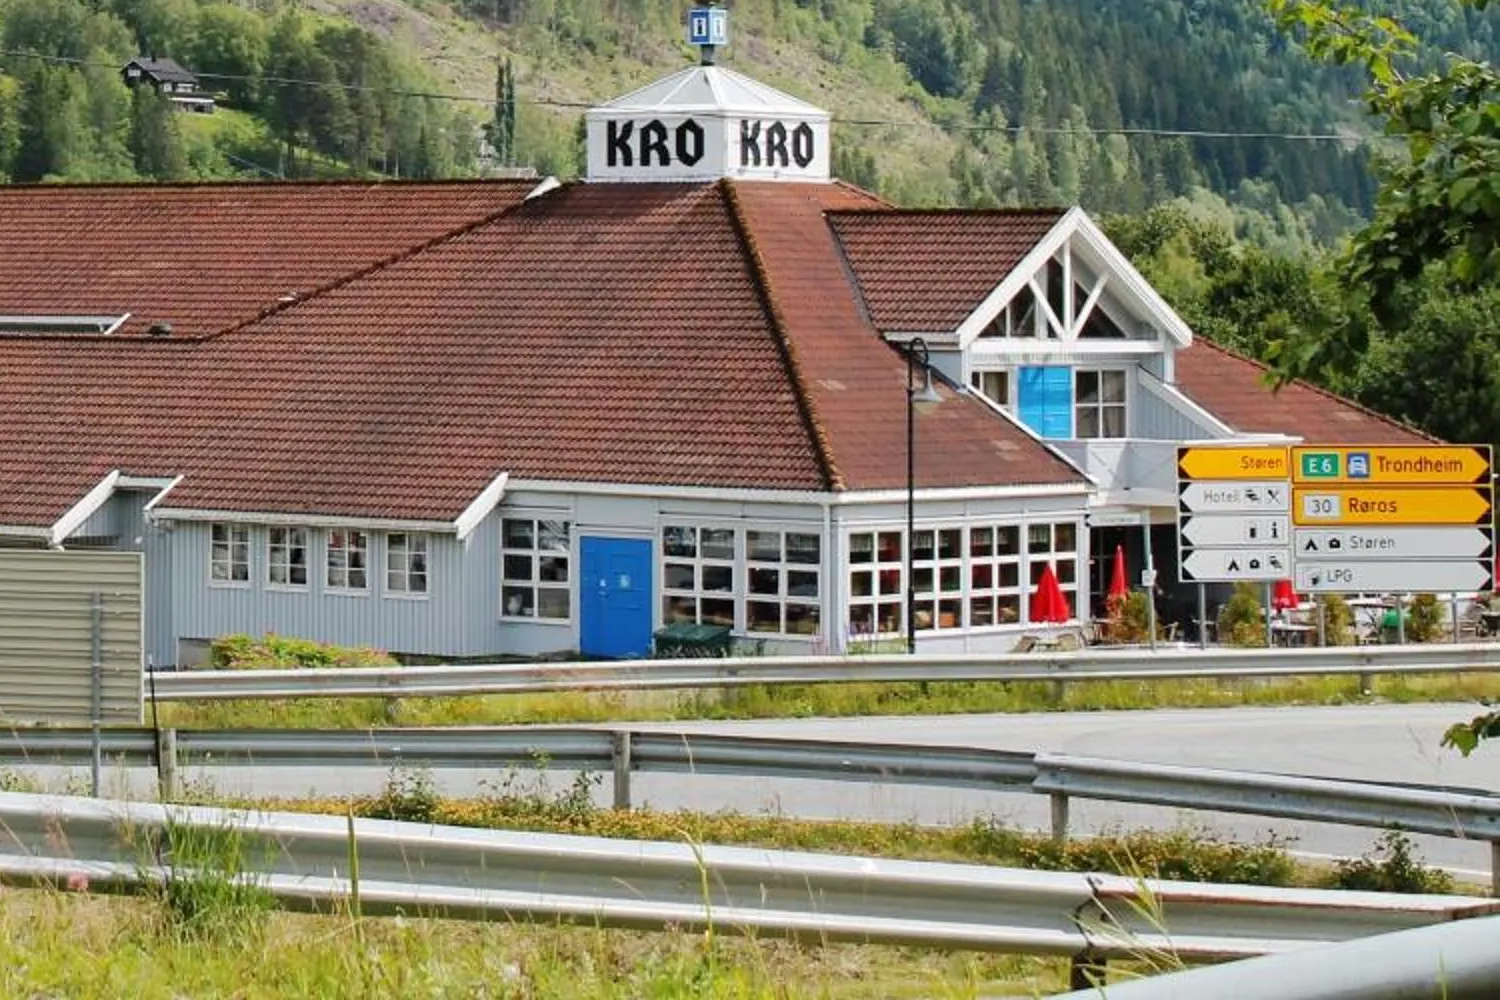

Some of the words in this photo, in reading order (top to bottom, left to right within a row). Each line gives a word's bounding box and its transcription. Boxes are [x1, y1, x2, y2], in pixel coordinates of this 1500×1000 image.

[607, 118, 705, 168] KRO
[740, 118, 815, 168] KRO
[1239, 455, 1283, 470] Støren
[1376, 455, 1463, 473] Trondheim
[1311, 499, 1332, 513] 30
[1348, 497, 1398, 513] Røros
[1349, 535, 1395, 549] Støren
[1327, 569, 1353, 584] LPG
